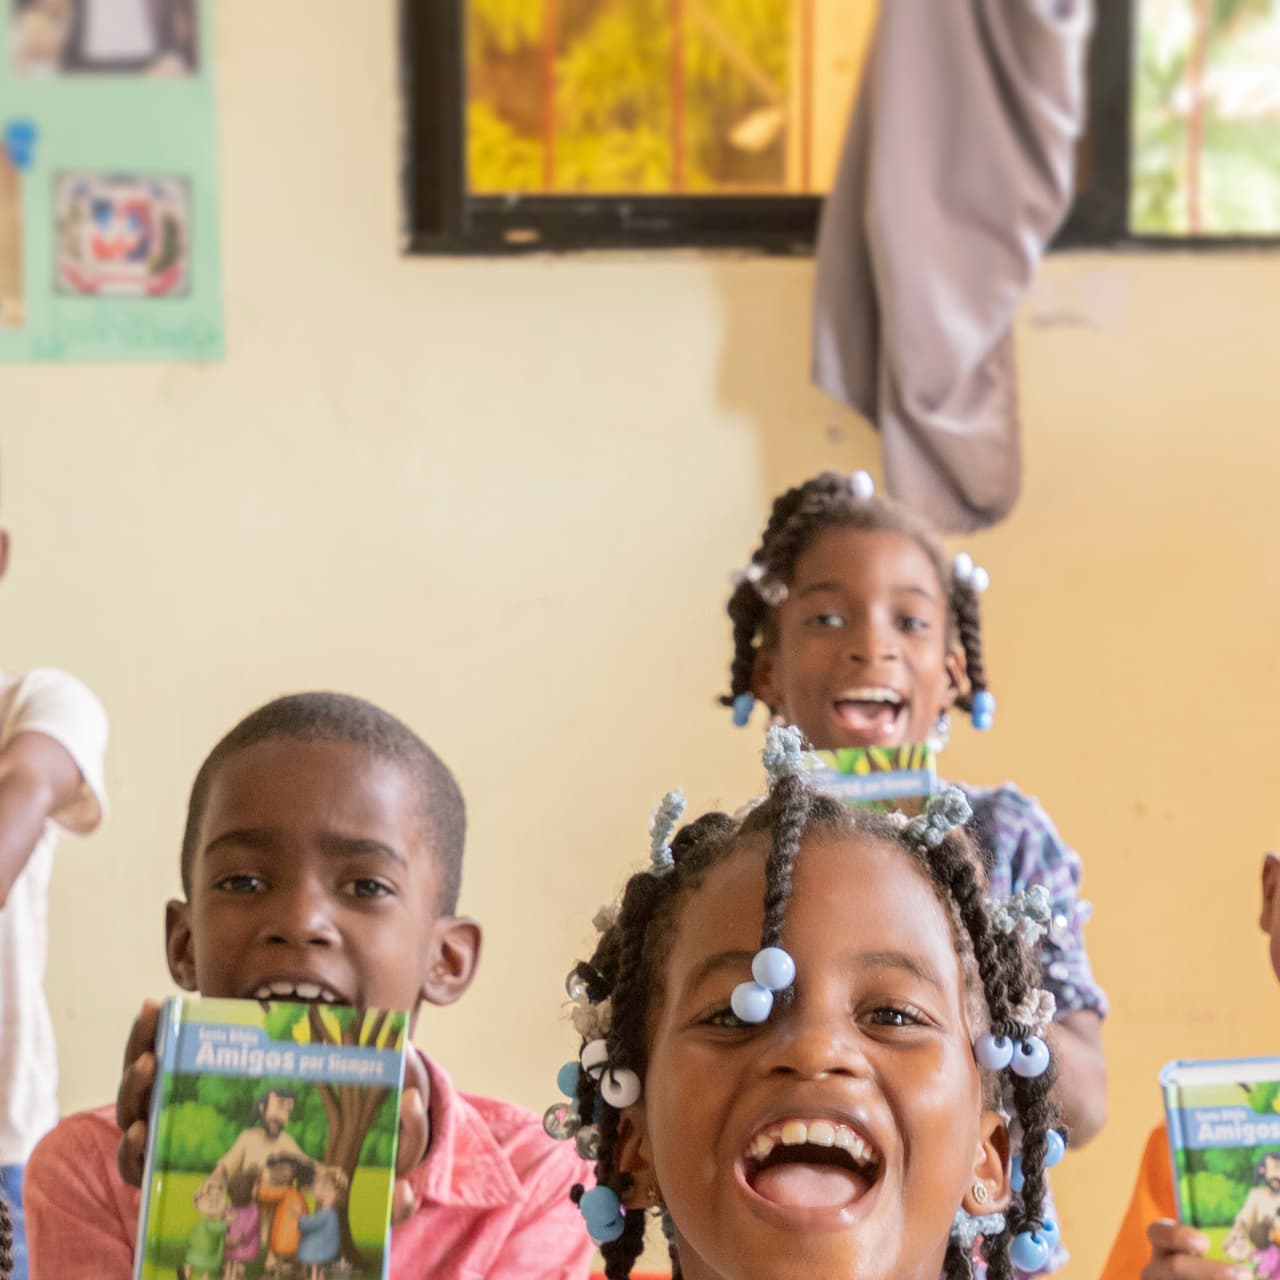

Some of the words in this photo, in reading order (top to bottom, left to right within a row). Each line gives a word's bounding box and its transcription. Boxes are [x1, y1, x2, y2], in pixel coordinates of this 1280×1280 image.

[195, 1040, 295, 1077] Amigos
[299, 1054, 325, 1074] por
[1198, 1119, 1280, 1145] Amigos
